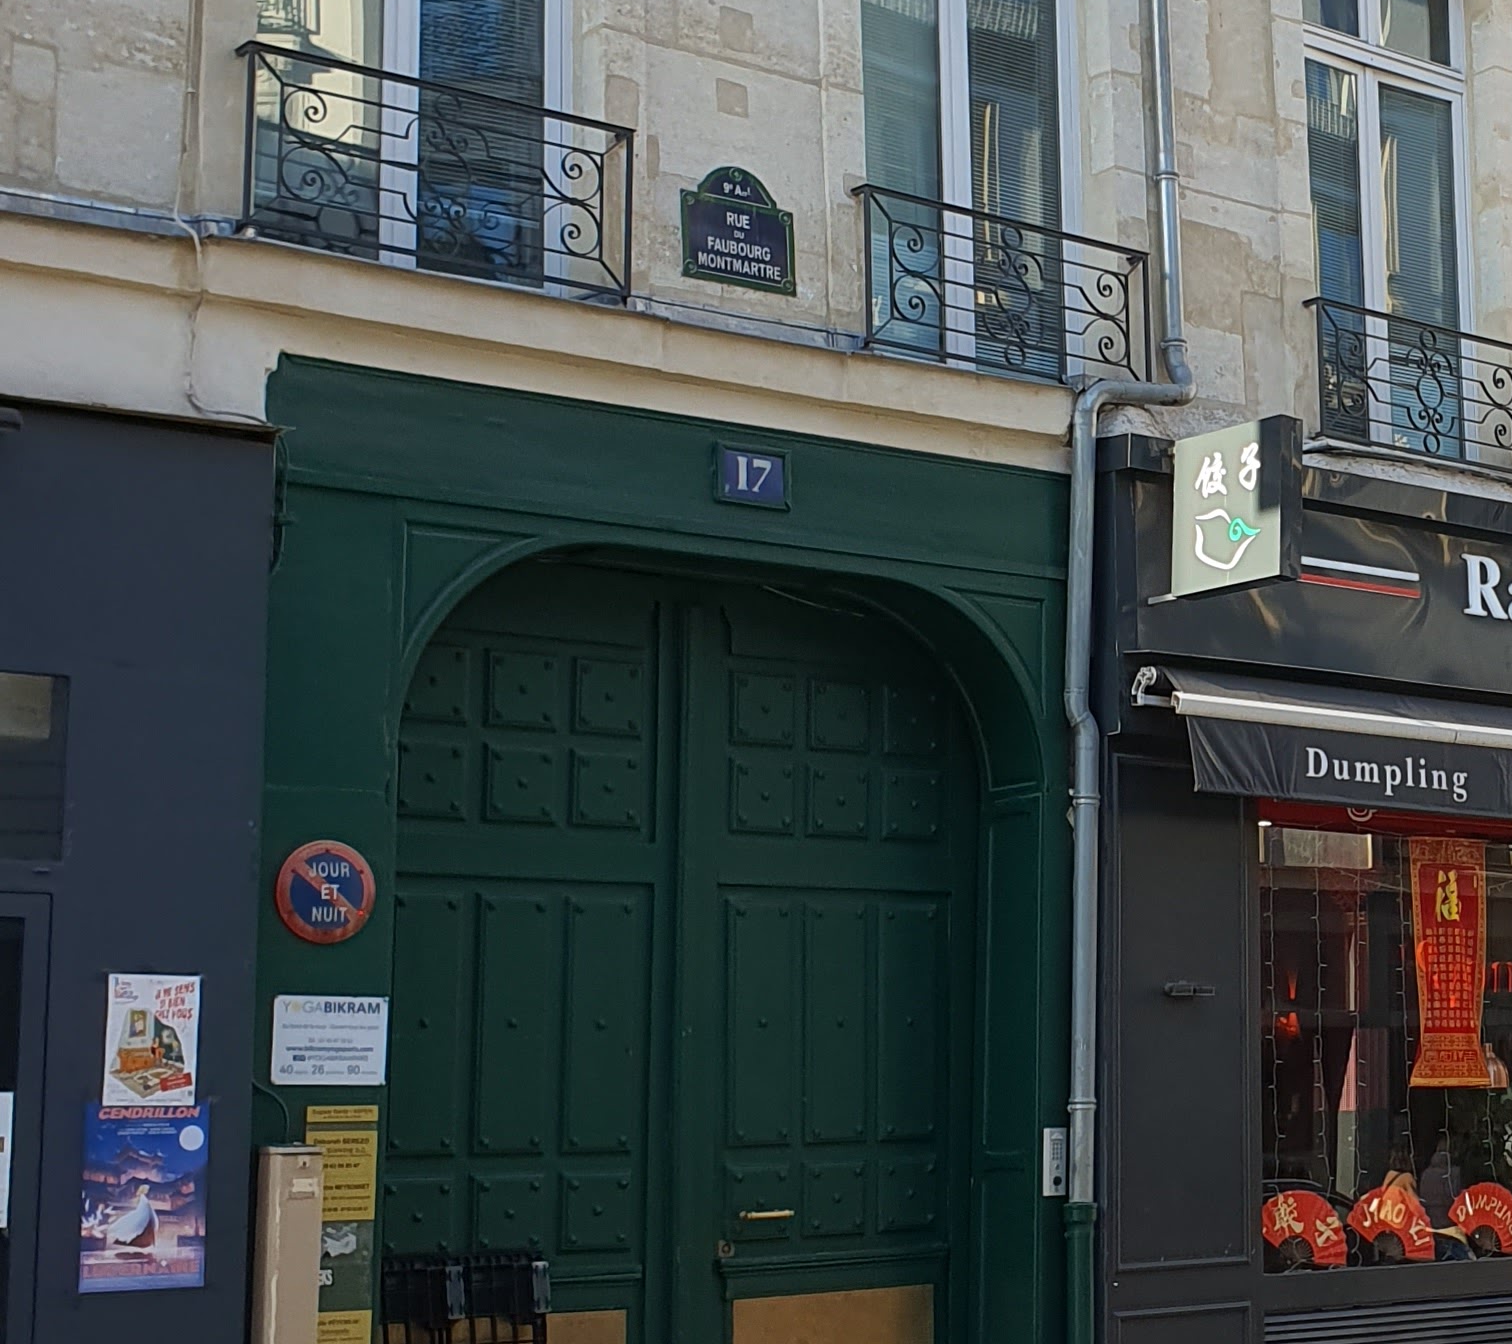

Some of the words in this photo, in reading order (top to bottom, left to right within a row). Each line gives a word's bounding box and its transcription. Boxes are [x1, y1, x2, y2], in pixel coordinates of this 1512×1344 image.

[726, 211, 751, 230] RUE
[733, 230, 745, 240] DU
[707, 236, 771, 262] FAUBOURG
[698, 251, 782, 281] MONTMARTRE
[737, 456, 772, 493] 17
[1305, 746, 1468, 803] Dumpling
[309, 861, 350, 878] JOUR
[321, 884, 340, 900] ET
[311, 906, 348, 923] NUIT
[98, 1106, 201, 1121] CENDRILLON
